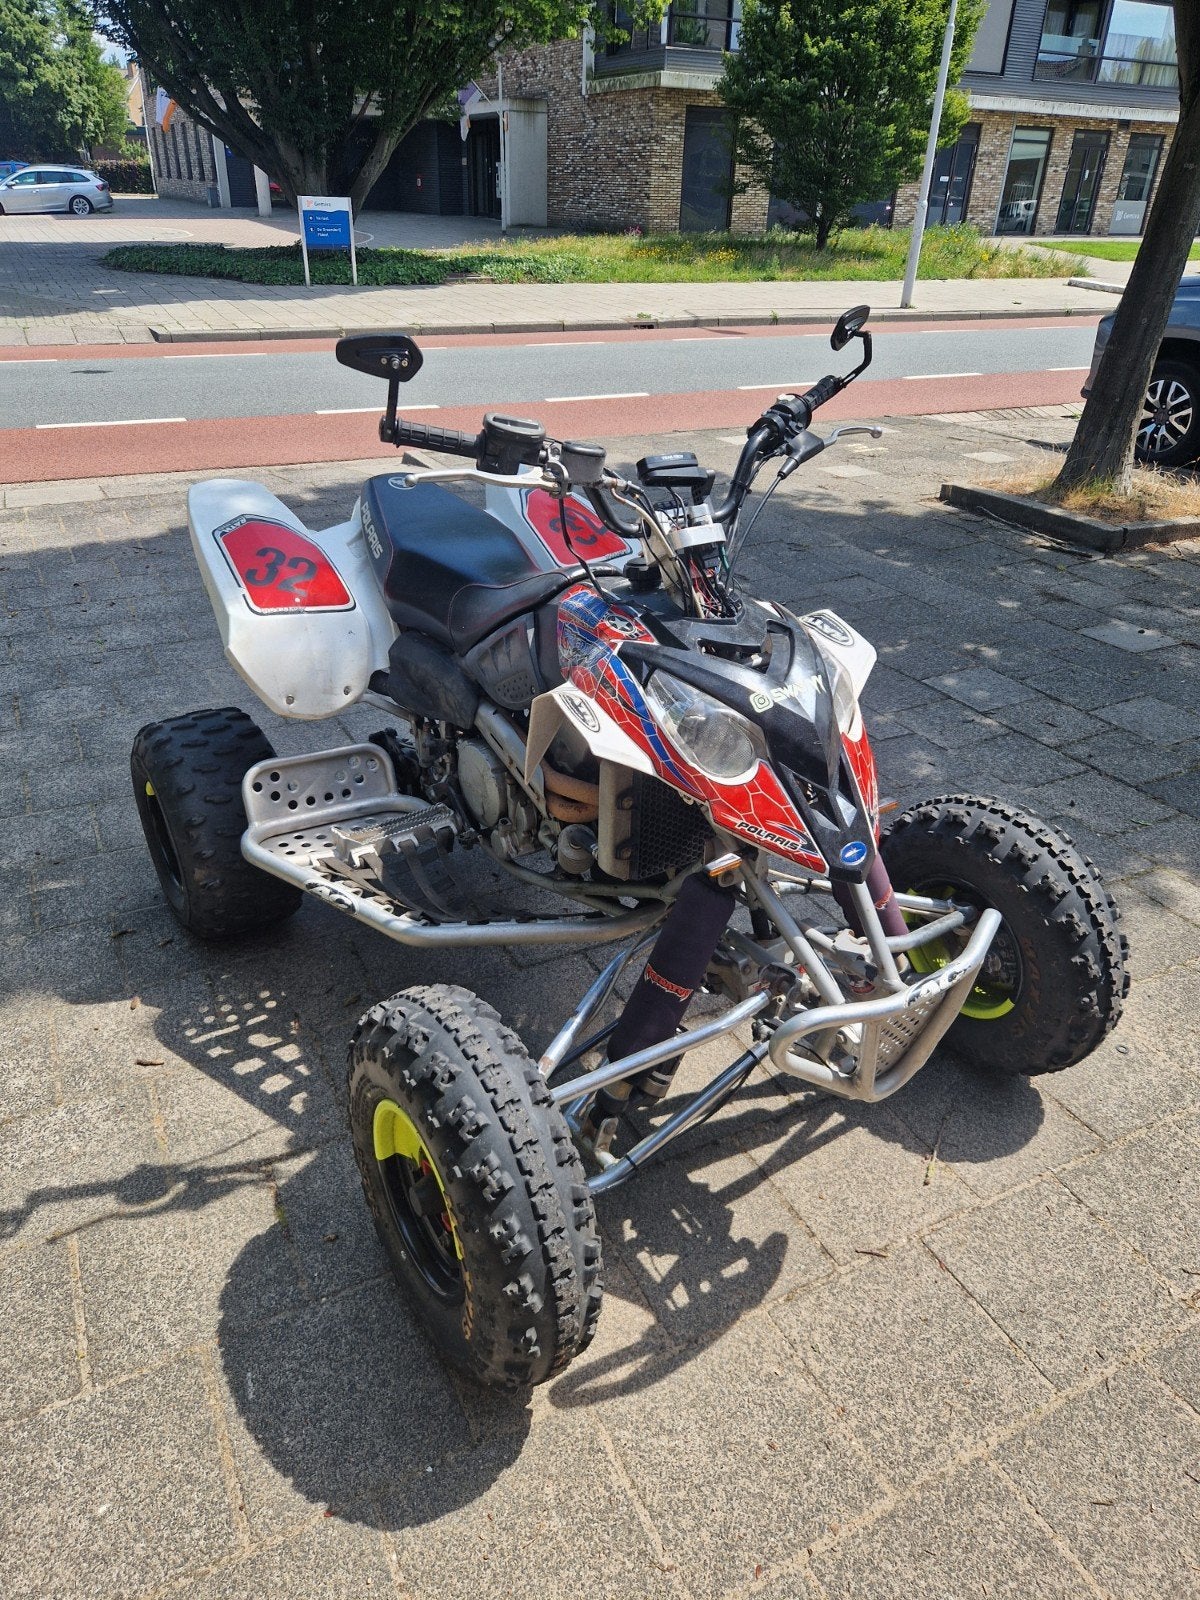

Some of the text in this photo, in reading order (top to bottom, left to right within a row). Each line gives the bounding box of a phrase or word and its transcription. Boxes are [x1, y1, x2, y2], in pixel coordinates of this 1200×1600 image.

[360, 501, 384, 560] POLARIS
[245, 547, 318, 597] 32
[736, 820, 801, 851] POLARIS
